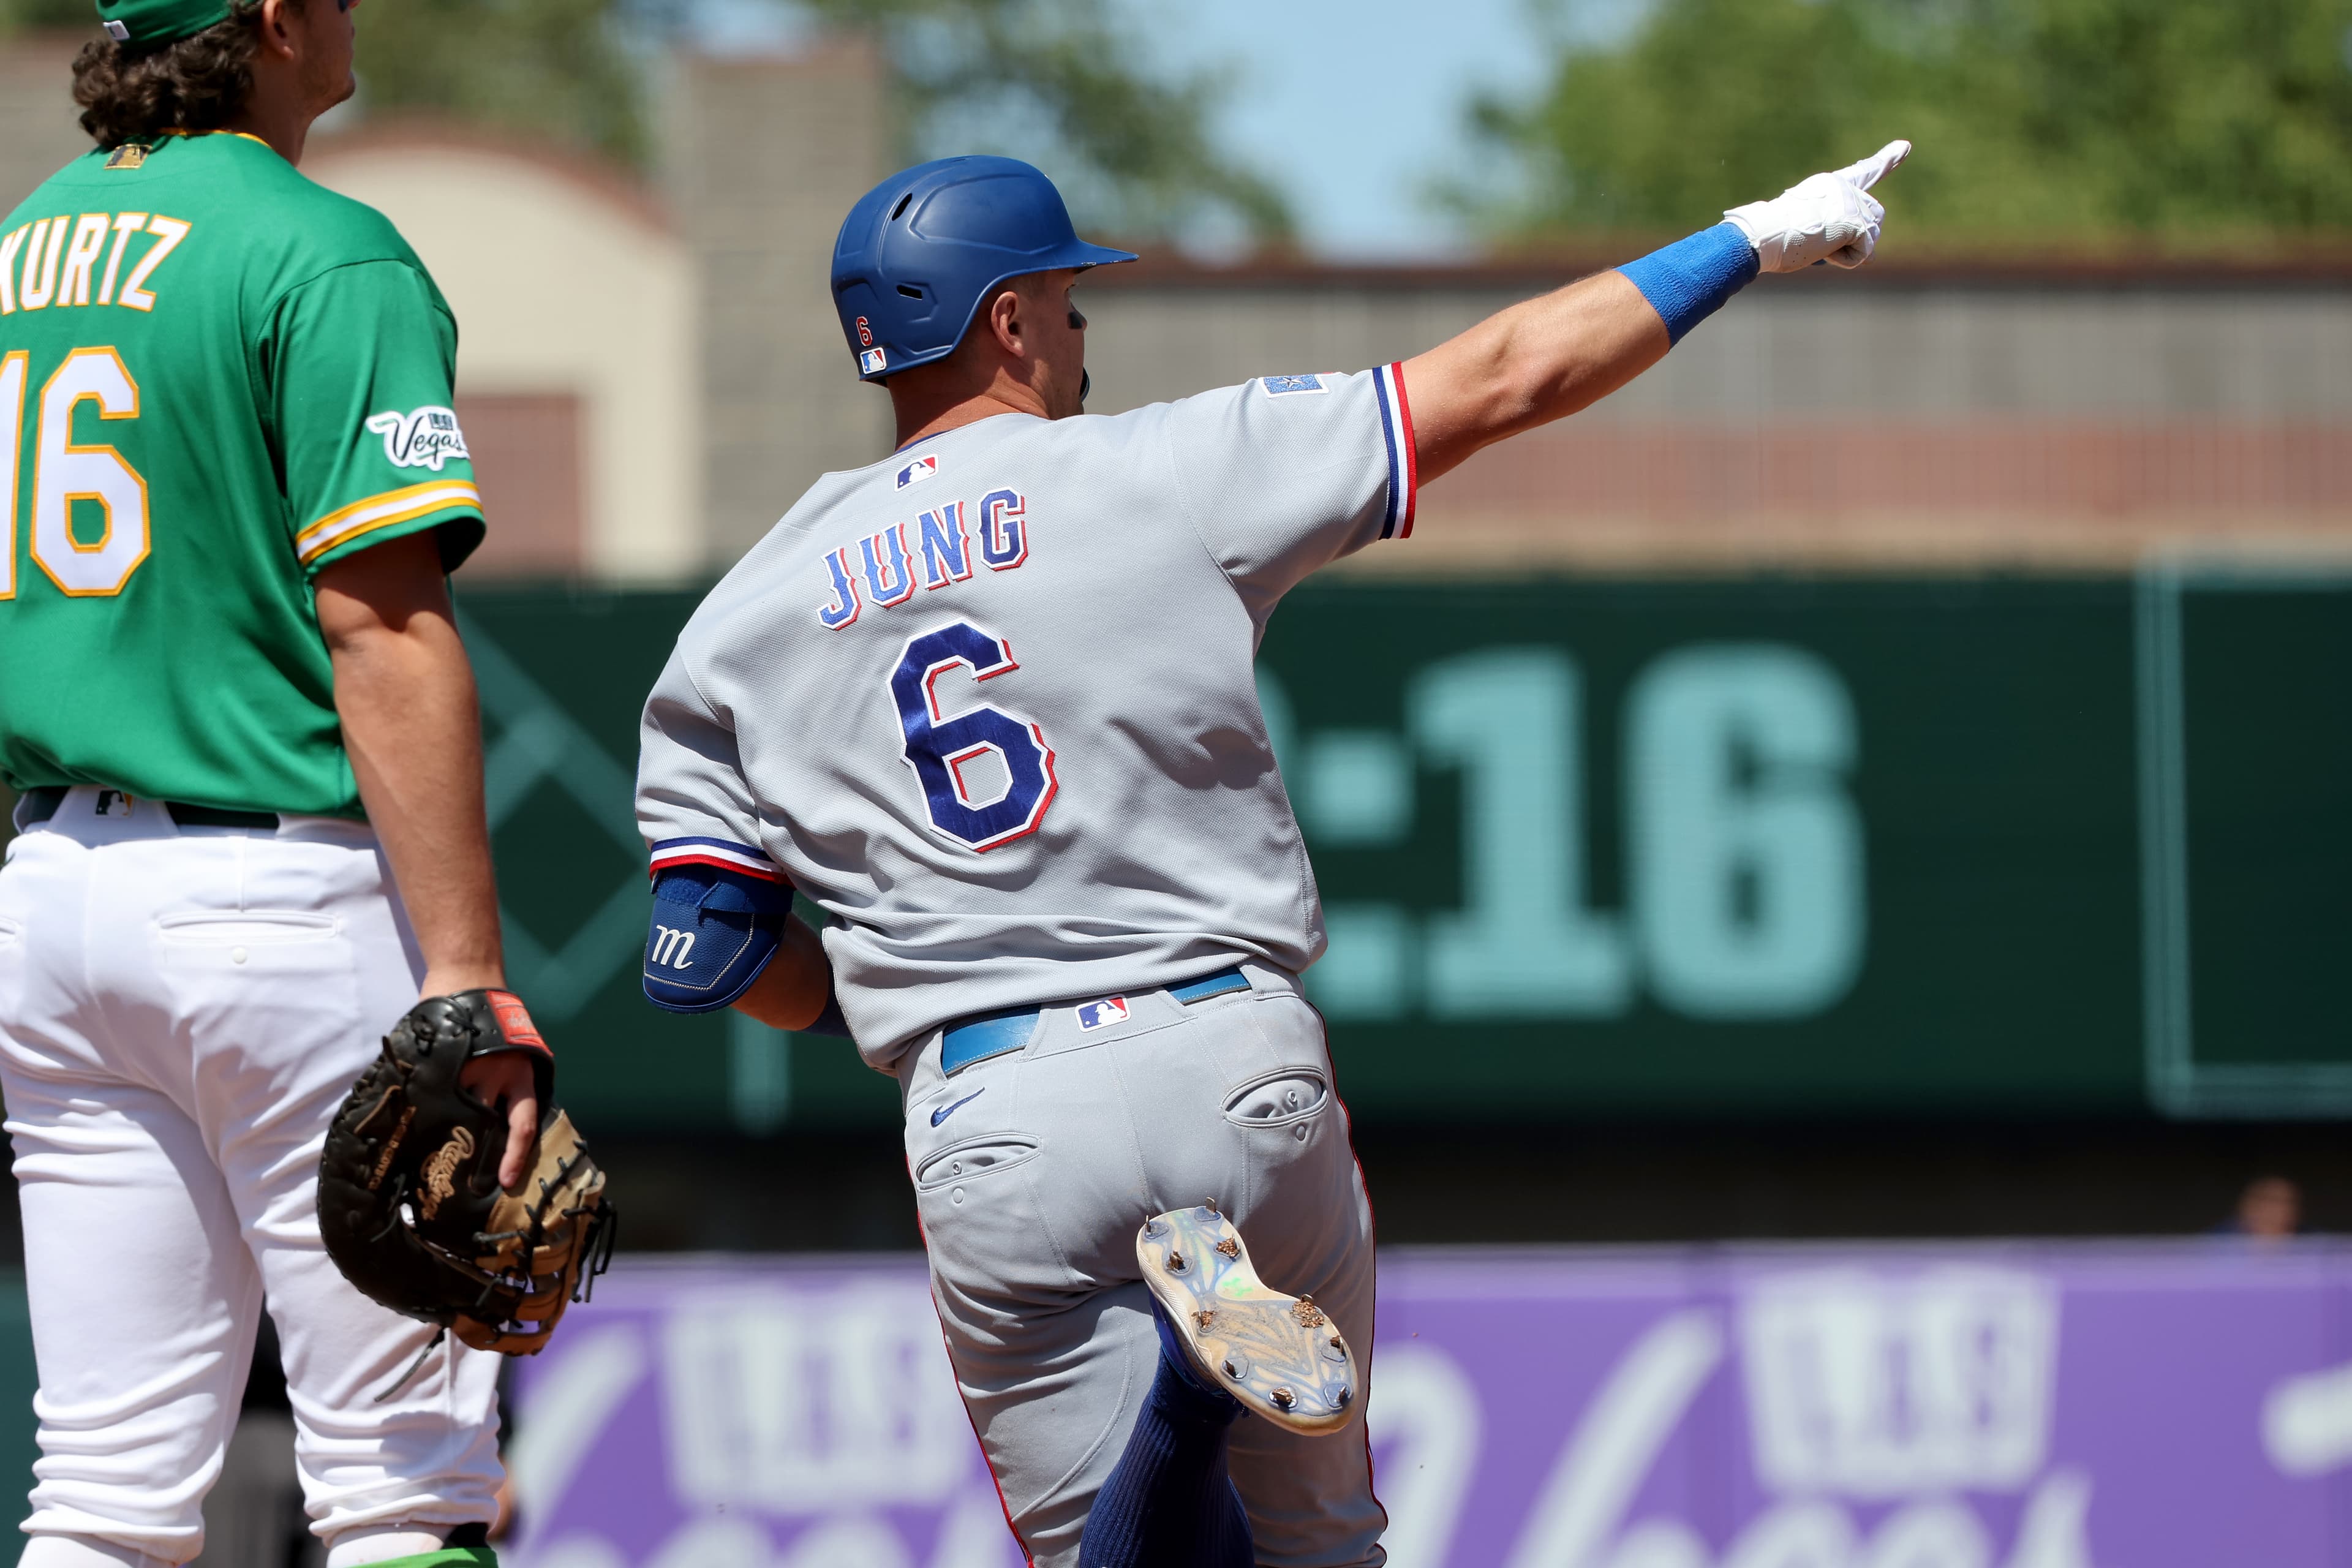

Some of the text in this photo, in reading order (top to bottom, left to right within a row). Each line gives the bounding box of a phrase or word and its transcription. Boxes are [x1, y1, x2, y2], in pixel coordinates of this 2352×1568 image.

[0, 212, 192, 315] KURTZ
[856, 316, 873, 347] 6
[816, 486, 1028, 631] JUNG
[886, 617, 1060, 854] 6
[1253, 637, 1869, 1024] :16
